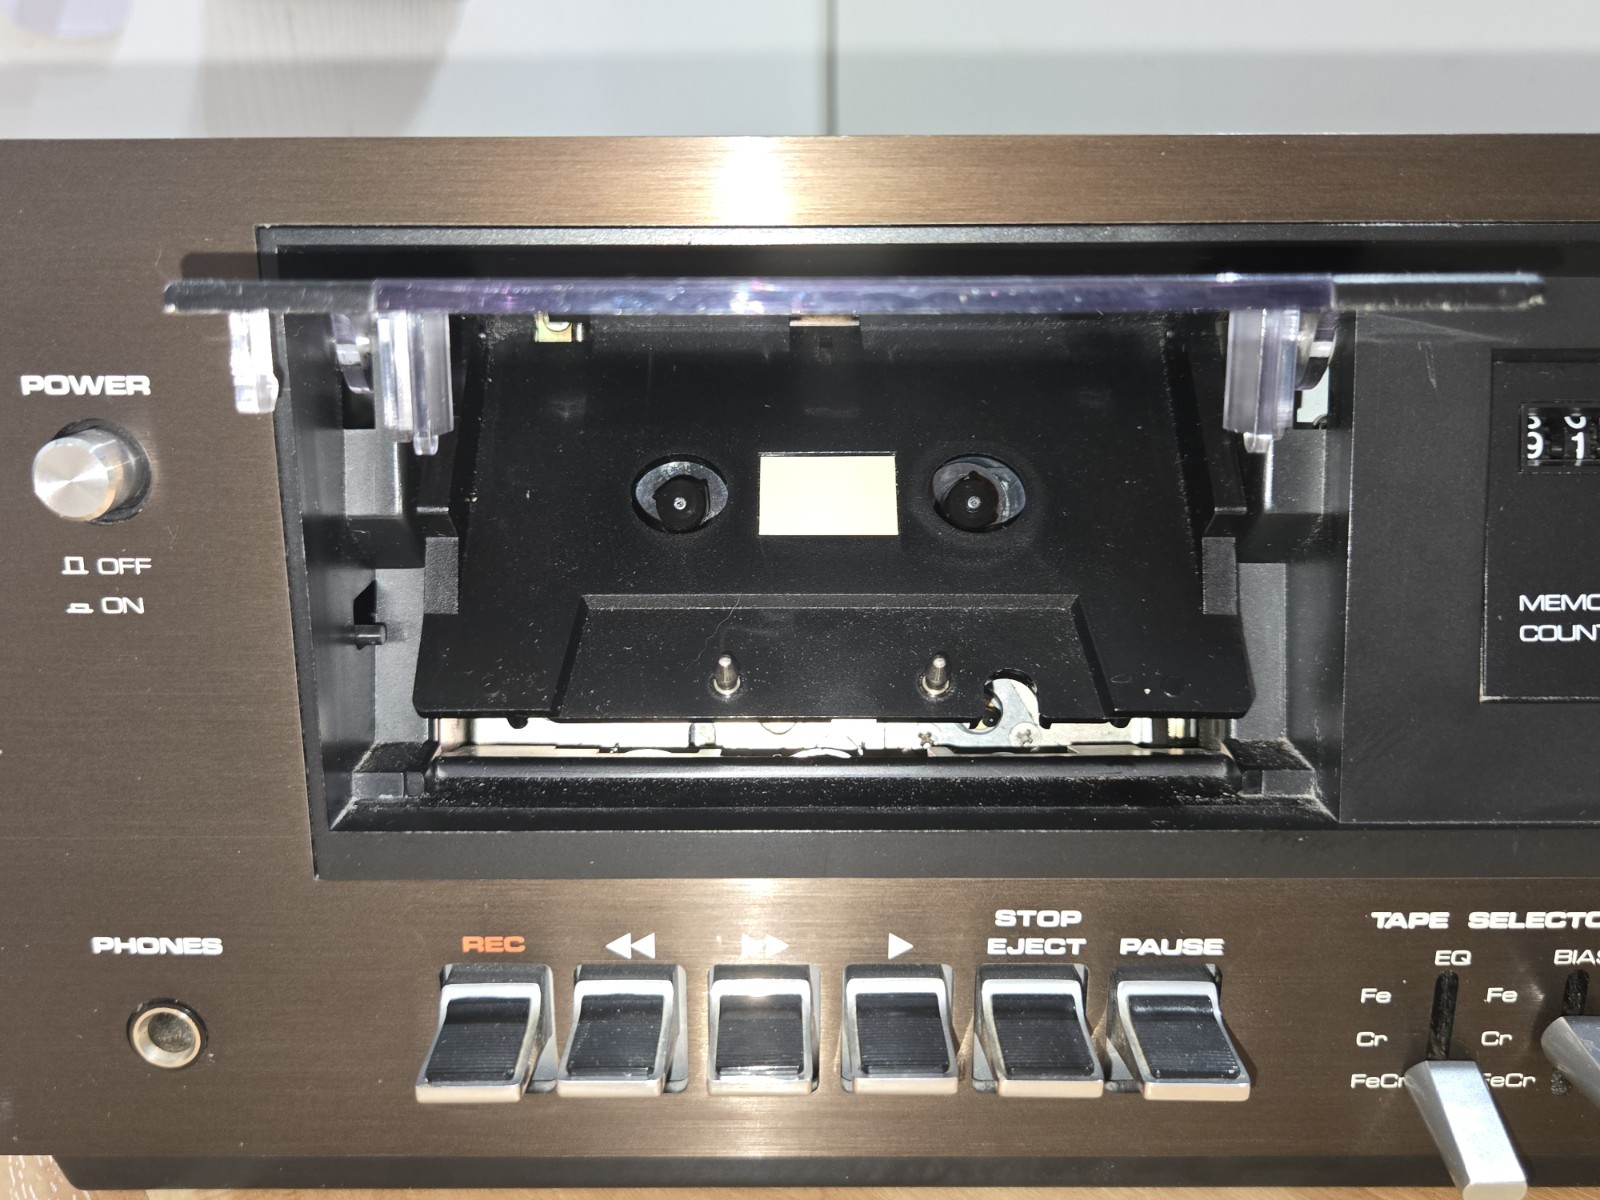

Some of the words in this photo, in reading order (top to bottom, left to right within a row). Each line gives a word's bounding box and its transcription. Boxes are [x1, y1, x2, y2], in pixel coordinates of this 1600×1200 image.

[21, 375, 151, 396] POWER
[97, 557, 152, 575] OFF
[101, 597, 144, 614] ON
[1519, 624, 1600, 642] COUN
[994, 909, 1082, 928] STOP
[1371, 911, 1450, 929] TAPE
[91, 936, 224, 955] PHONES
[462, 936, 526, 953] REC
[987, 938, 1087, 956] EJECT
[1120, 938, 1225, 957] PAUSE
[1434, 950, 1472, 966] EQ
[1554, 949, 1600, 966] BIA
[1360, 988, 1392, 1004] Fe
[1486, 987, 1518, 1003] Fe
[1356, 1031, 1388, 1047] Cr
[1481, 1031, 1513, 1046] Cr
